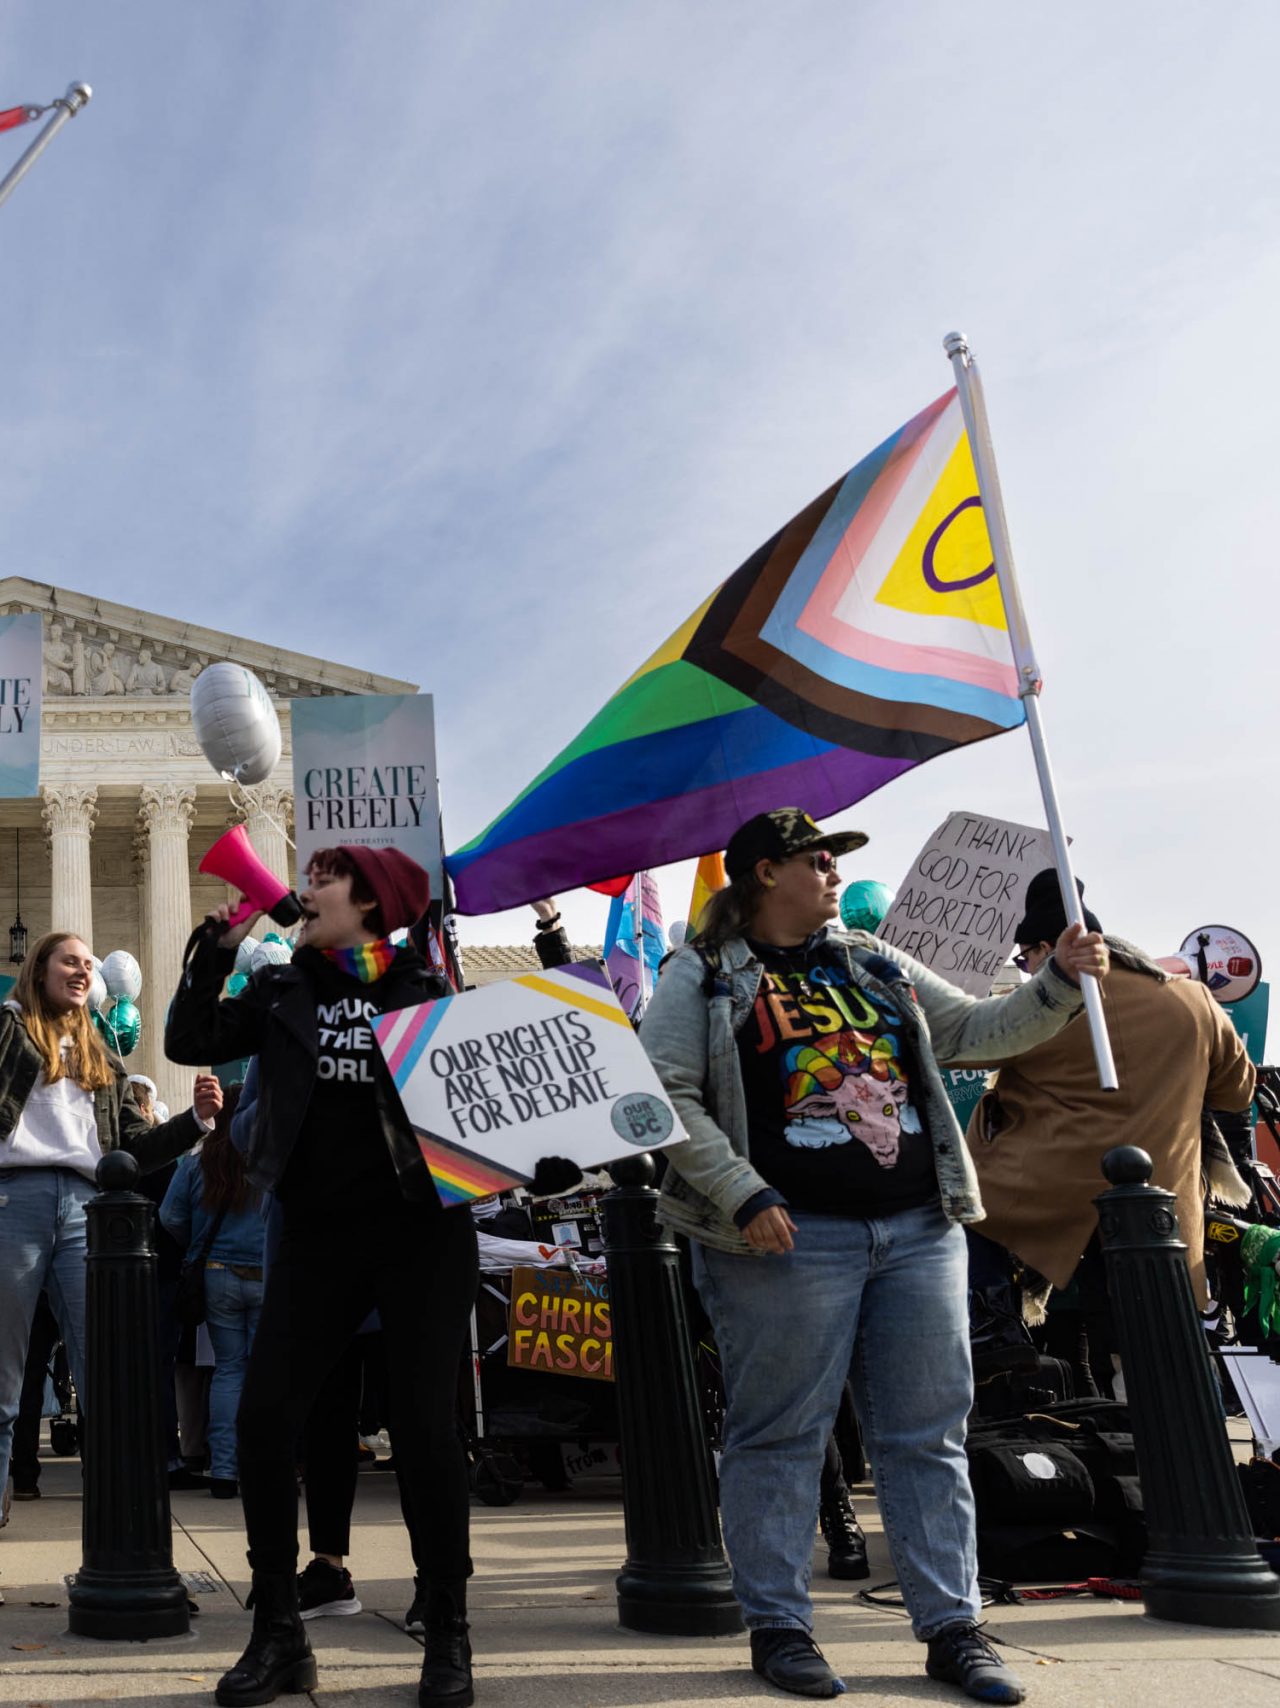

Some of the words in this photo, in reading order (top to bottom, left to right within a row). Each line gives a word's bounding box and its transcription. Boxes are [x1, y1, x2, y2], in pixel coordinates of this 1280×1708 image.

[41, 738, 110, 753] UNDER
[115, 738, 155, 753] LAW
[303, 765, 427, 799] CREATE
[307, 796, 426, 830] FREELY
[937, 819, 953, 840] I
[955, 818, 1036, 861] THANK
[919, 849, 968, 890] GOD
[967, 866, 1019, 903] FOR
[895, 888, 1016, 944] ABORTION
[946, 940, 1003, 977] SINGLE
[318, 1026, 373, 1050] THE
[430, 1039, 492, 1078] OUR
[485, 1010, 591, 1063] RIGHTS
[317, 1055, 375, 1082] ORL
[444, 1068, 500, 1110] ARE
[496, 1051, 554, 1093] NOT
[555, 1041, 596, 1075] UP
[450, 1099, 513, 1139] FOR
[509, 1067, 619, 1123] DEBATE
[629, 1117, 662, 1138] DC
[515, 1292, 612, 1338] CHRIS
[514, 1329, 612, 1377] FASCI
